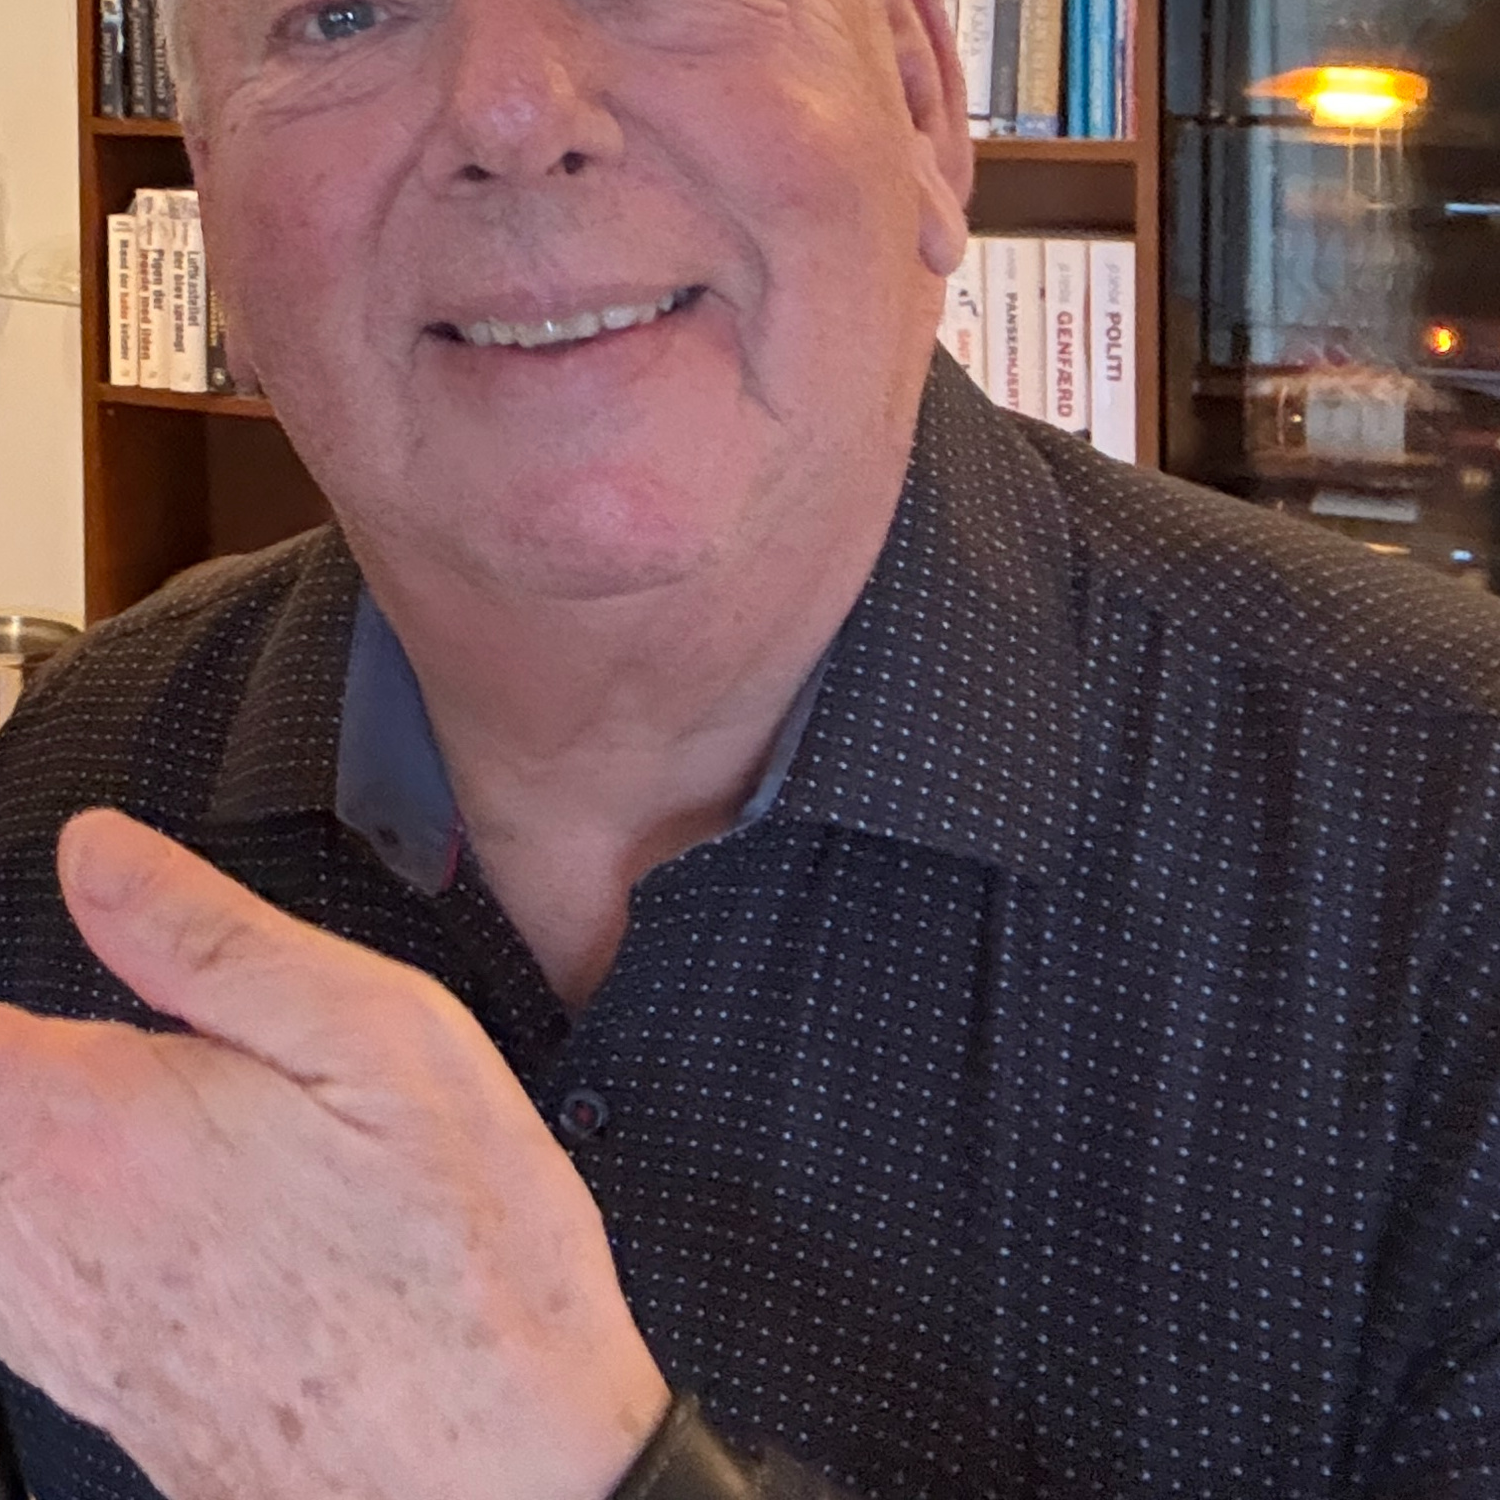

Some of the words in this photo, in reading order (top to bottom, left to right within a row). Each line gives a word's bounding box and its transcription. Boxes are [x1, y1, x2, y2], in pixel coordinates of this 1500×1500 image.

[152, 249, 165, 286] Pigen
[174, 250, 186, 270] der
[119, 273, 130, 289] der
[174, 273, 186, 300] blev
[140, 296, 152, 324] med
[153, 289, 166, 311] der
[1106, 312, 1123, 382] POLITI
[1056, 310, 1074, 418] GENFÆRD
